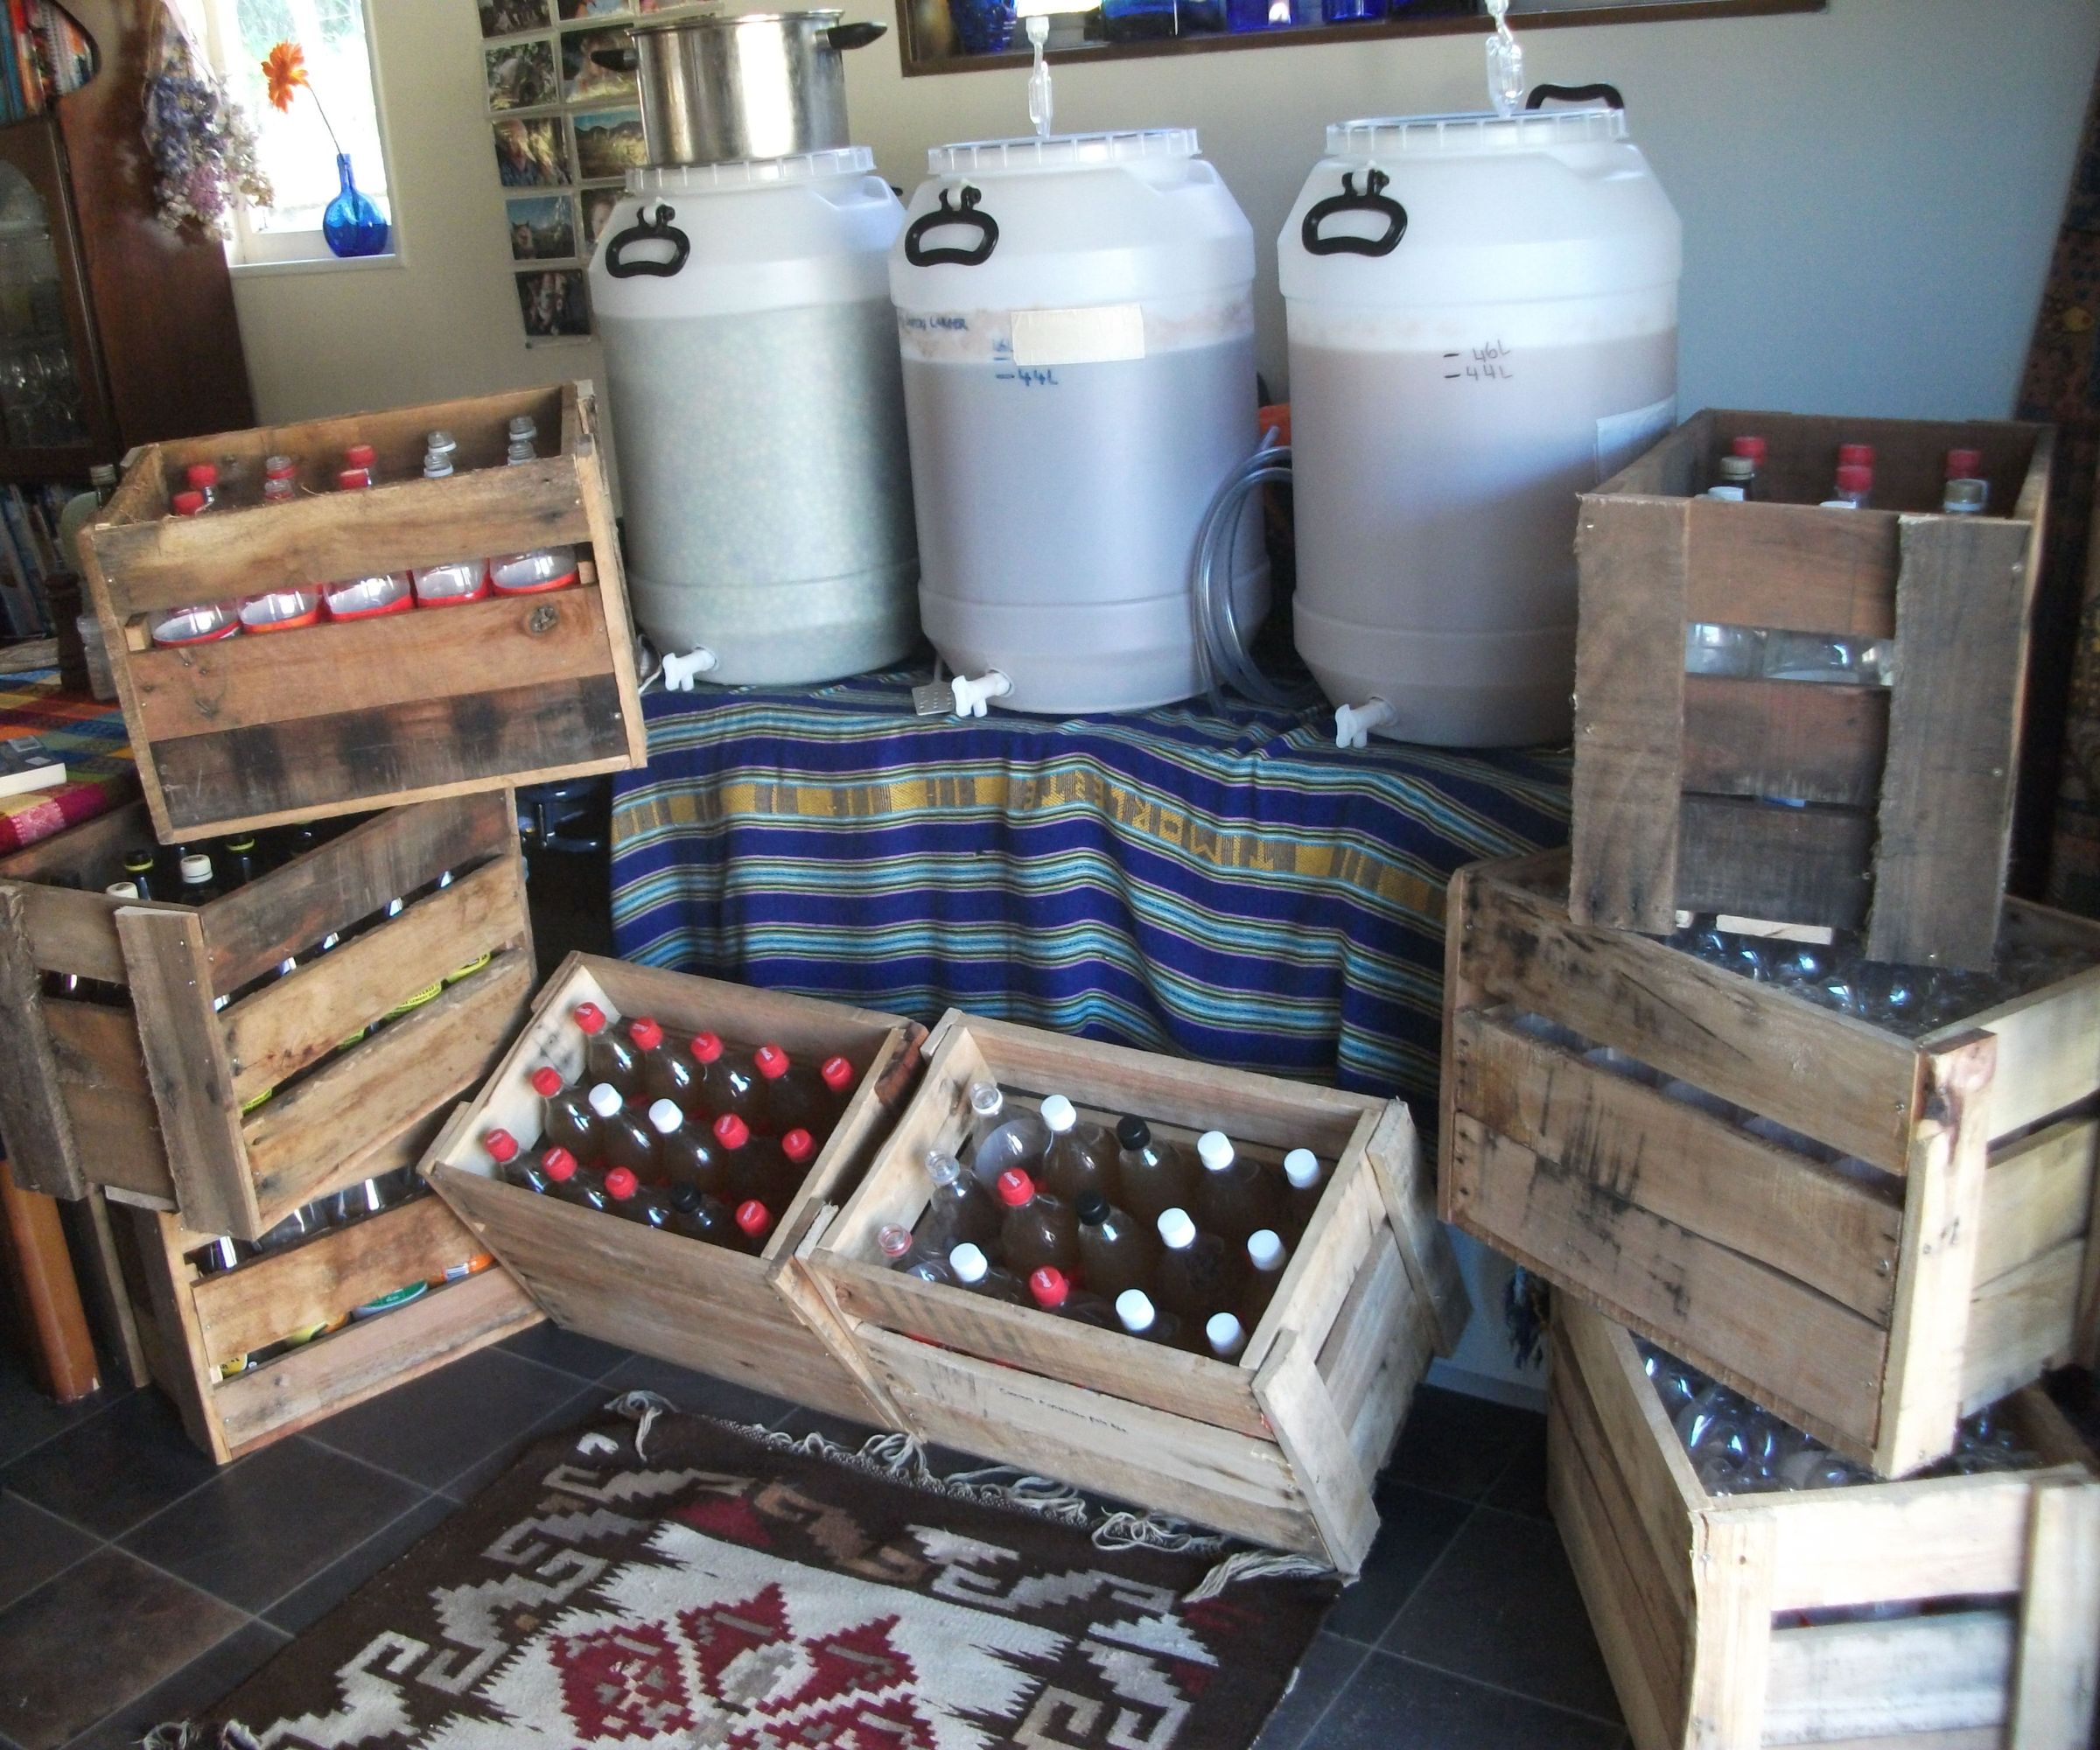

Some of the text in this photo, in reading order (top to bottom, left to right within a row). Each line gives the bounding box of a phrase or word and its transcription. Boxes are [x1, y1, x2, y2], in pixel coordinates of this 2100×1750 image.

[1472, 340, 1511, 362] 46L
[1018, 368, 1058, 387] 44L
[1466, 364, 1513, 381] 44L
